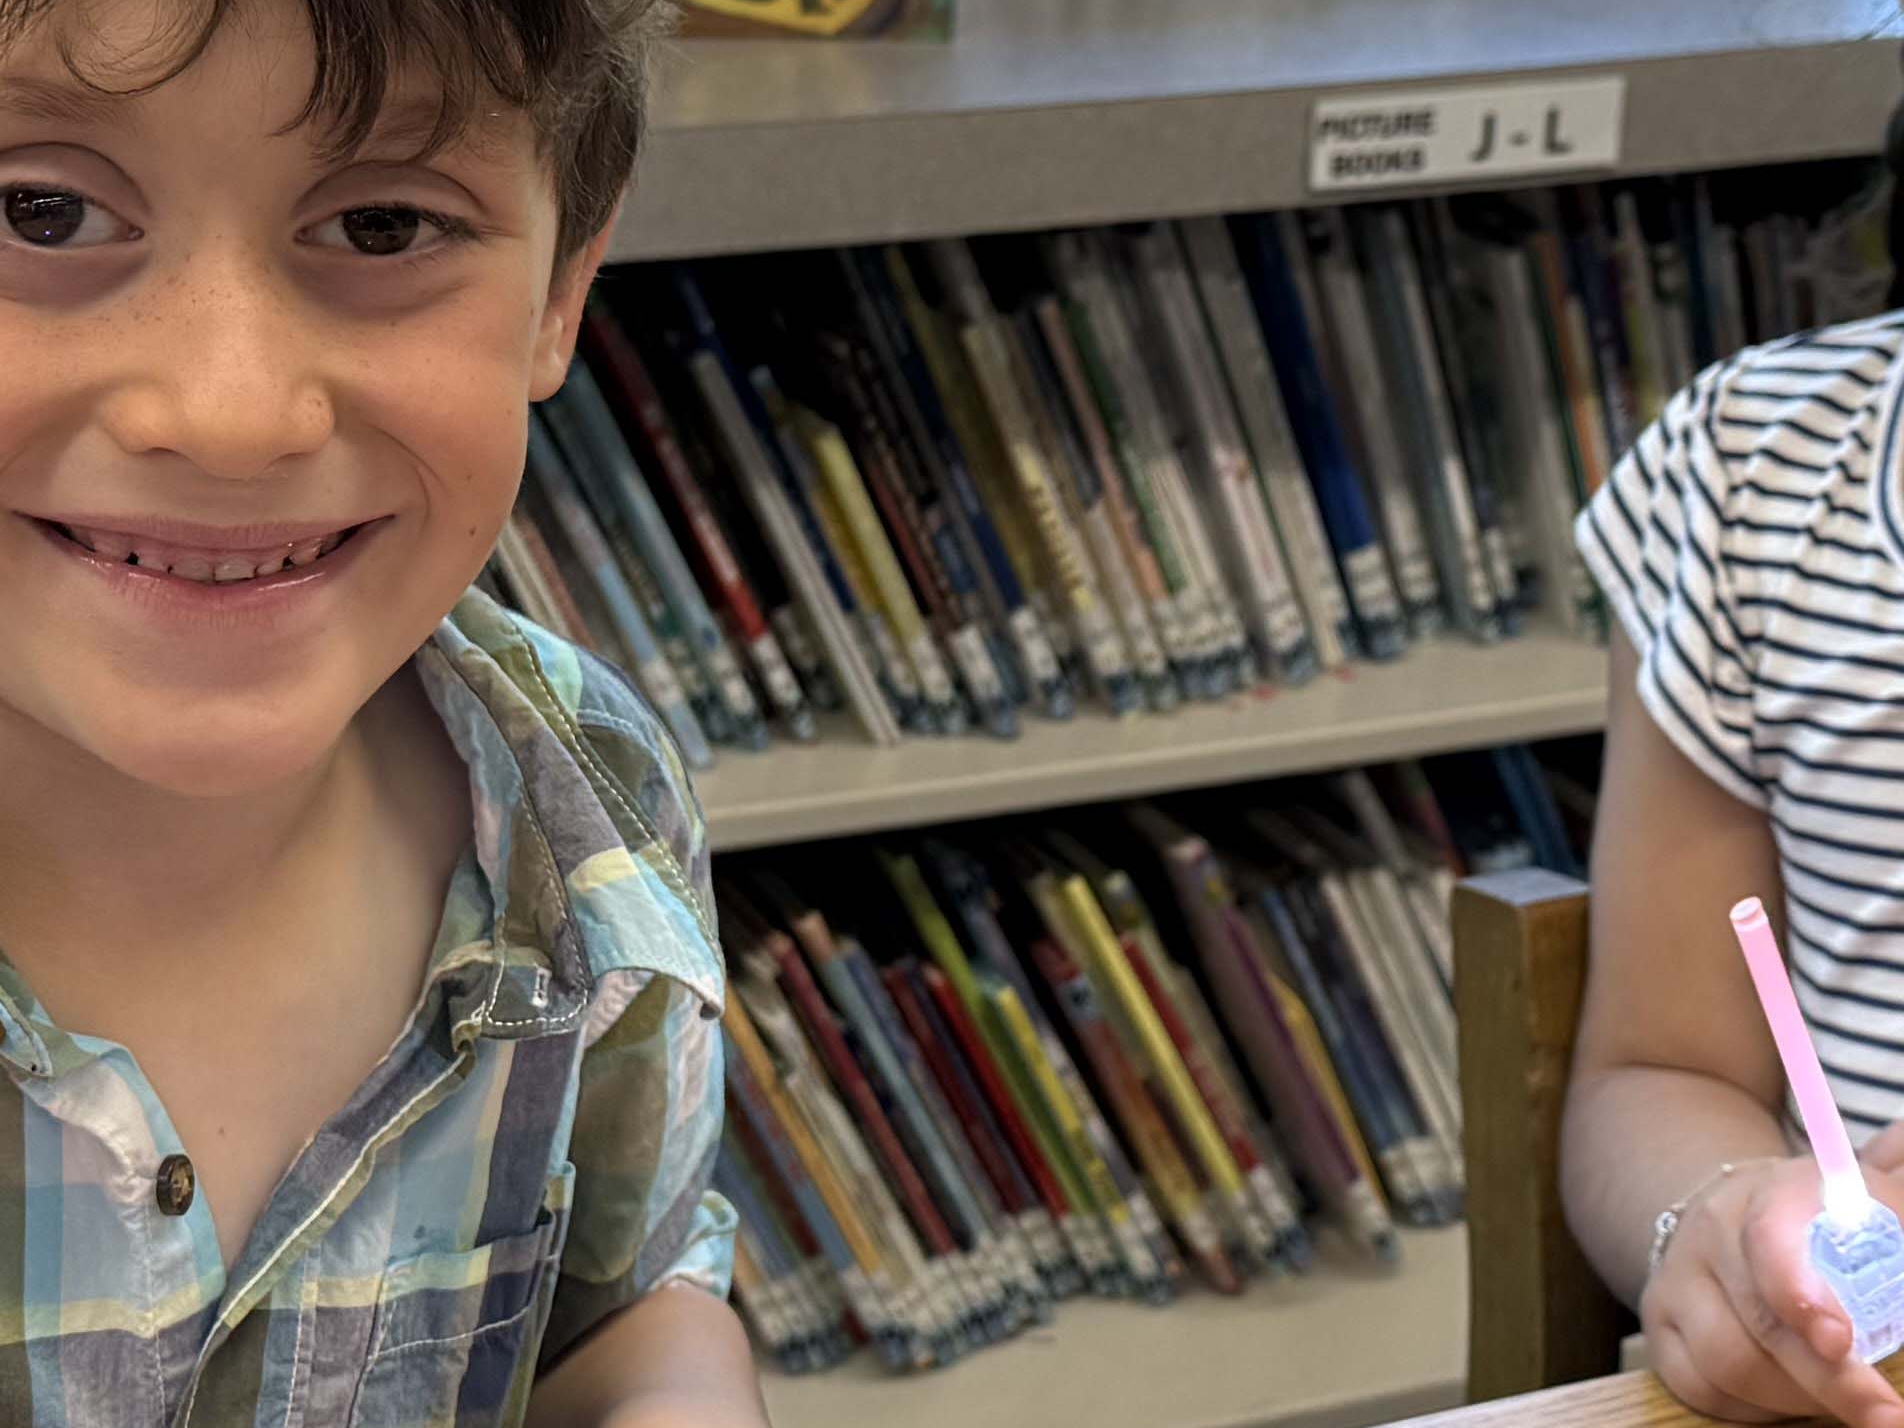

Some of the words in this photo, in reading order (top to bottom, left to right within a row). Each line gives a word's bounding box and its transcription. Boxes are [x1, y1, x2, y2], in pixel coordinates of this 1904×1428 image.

[1318, 107, 1438, 141] PICTURE
[1469, 112, 1498, 164] J
[1543, 105, 1575, 155] L
[1329, 148, 1427, 179] BOOKS
